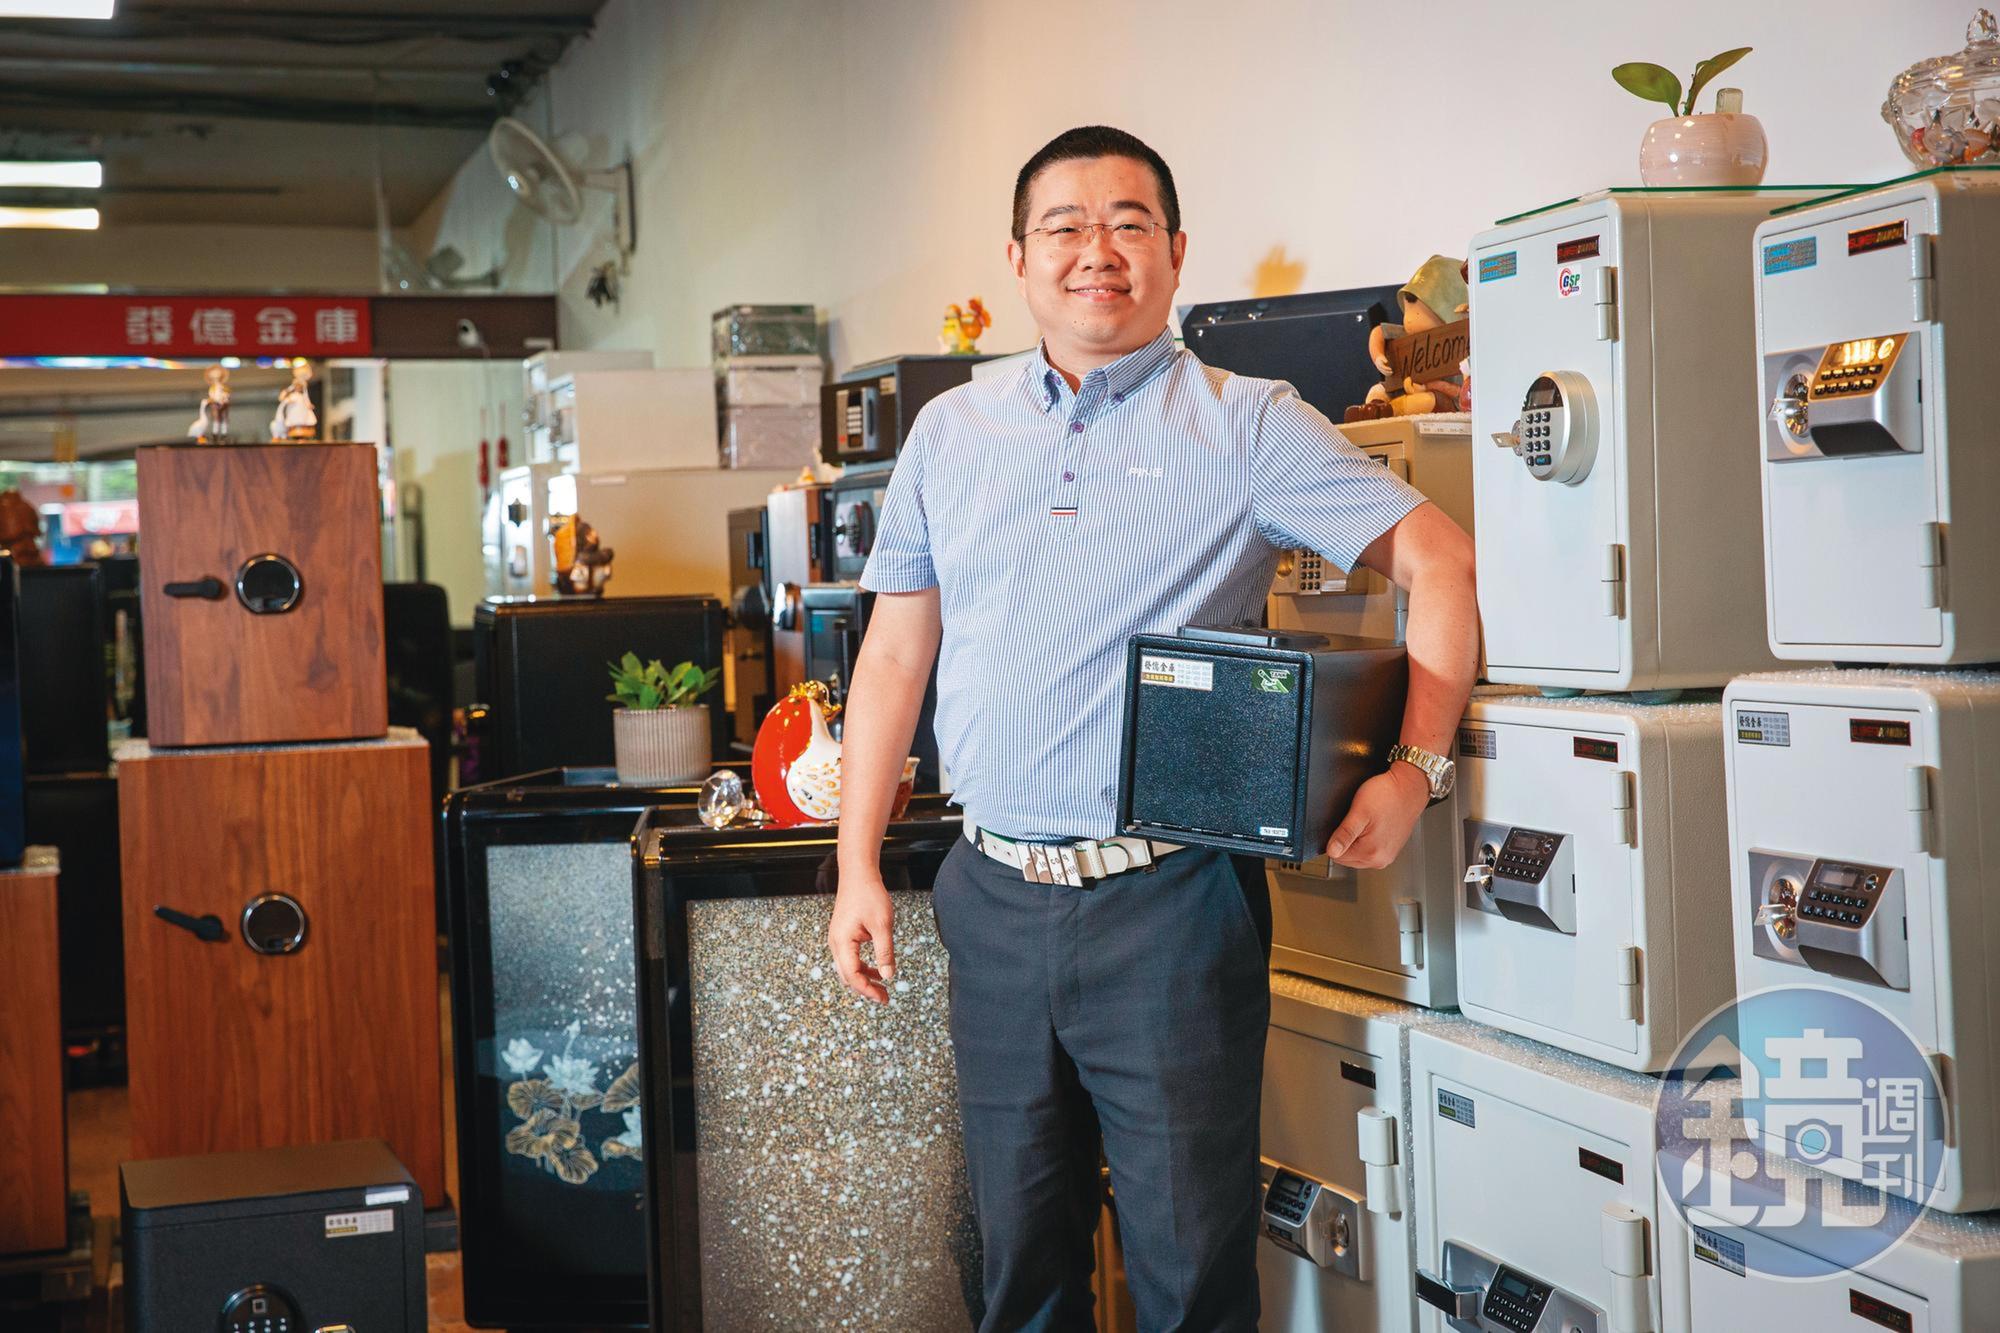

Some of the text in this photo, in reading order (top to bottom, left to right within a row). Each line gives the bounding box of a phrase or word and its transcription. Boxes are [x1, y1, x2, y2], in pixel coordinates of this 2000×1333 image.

[1563, 273, 1580, 288] GSP
[126, 306, 359, 345] 發億金庫
[1401, 334, 1470, 378] Welcom
